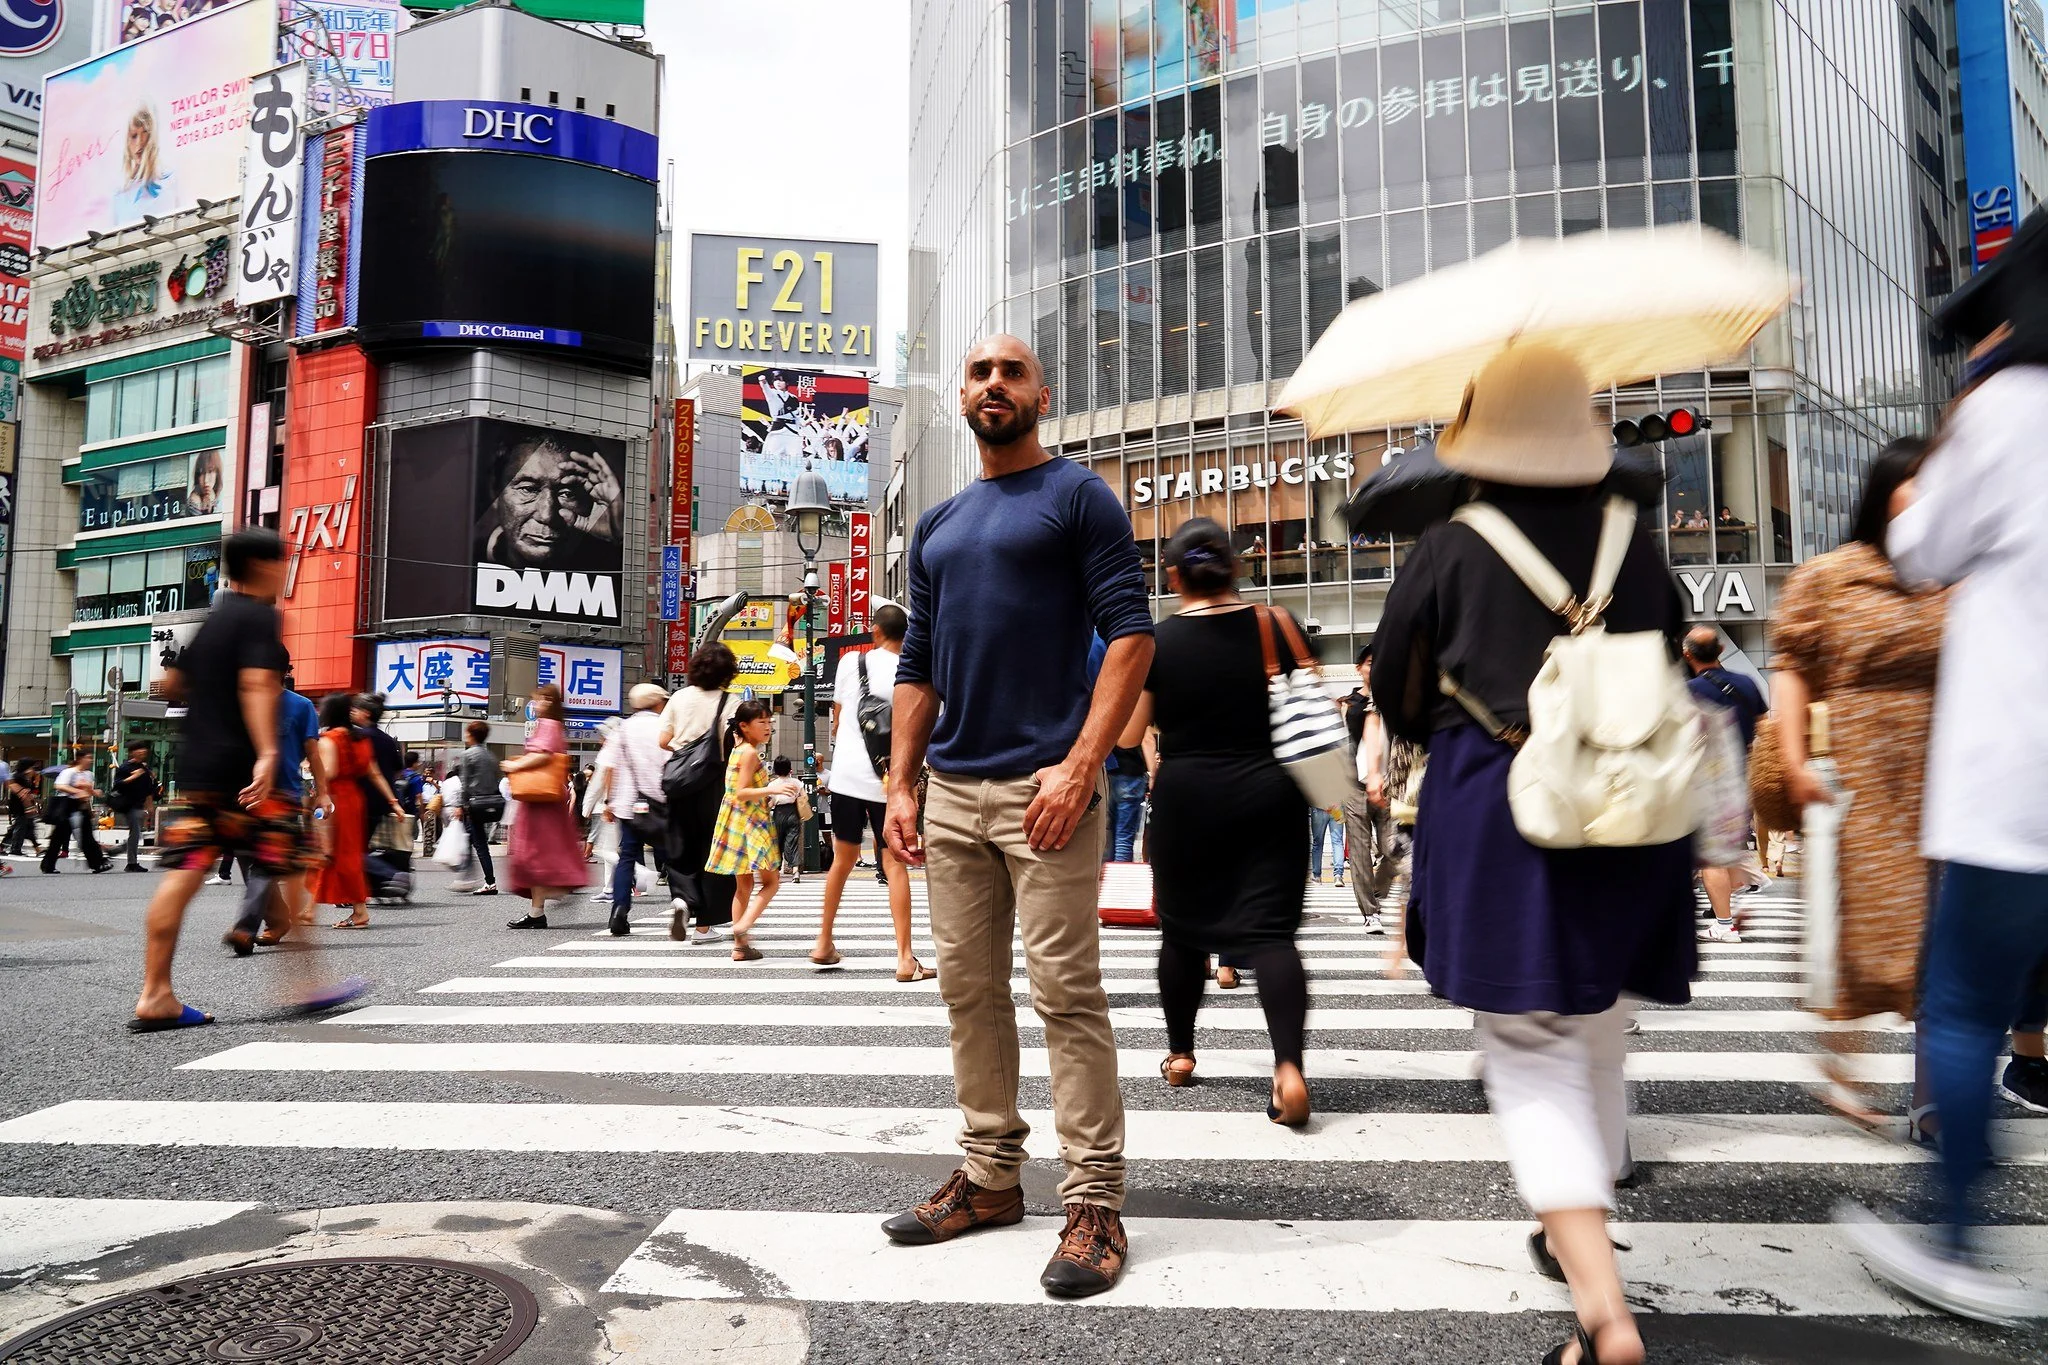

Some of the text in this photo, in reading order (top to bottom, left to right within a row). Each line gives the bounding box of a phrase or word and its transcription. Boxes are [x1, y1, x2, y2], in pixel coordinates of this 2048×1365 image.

[170, 87, 219, 114] TAYLOR
[170, 117, 190, 131] NEW
[194, 104, 226, 122] ALBUM
[462, 108, 554, 143] DHC
[242, 74, 298, 292] もんじゃ
[1973, 185, 2012, 271] SEI
[736, 247, 834, 314] F21
[0, 304, 28, 326] 2F
[459, 323, 544, 341] DHC Channel
[695, 317, 872, 356] FOREVER 21
[675, 403, 691, 505] クスリのことなら
[1134, 451, 1355, 503] STARBUCKS
[85, 497, 181, 529] Euphoria
[285, 474, 358, 598] クスリ
[665, 551, 677, 616] 大盛堂商事ビル
[851, 524, 869, 602] カラオケ
[117, 603, 138, 618] DARTS
[476, 562, 618, 618] DMM
[1677, 570, 1756, 613] YA
[569, 697, 612, 706] BOOKS TAISEIDO
